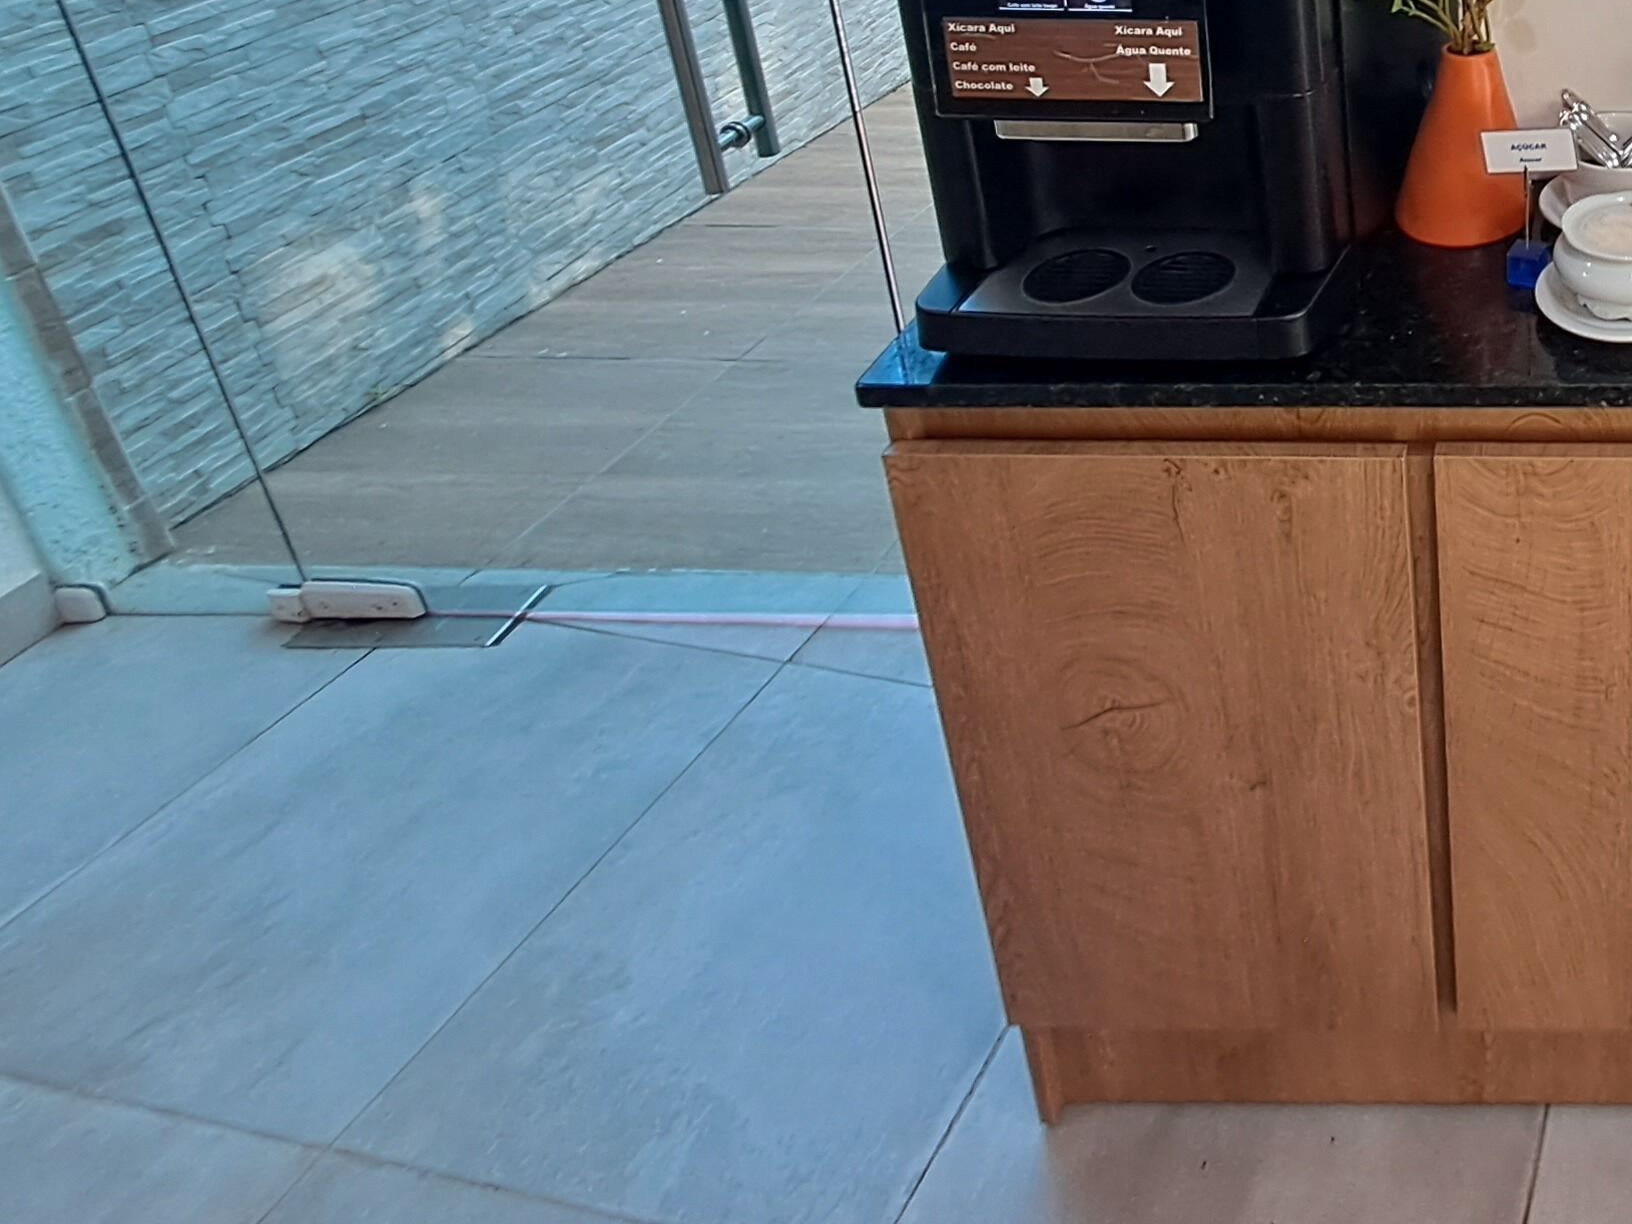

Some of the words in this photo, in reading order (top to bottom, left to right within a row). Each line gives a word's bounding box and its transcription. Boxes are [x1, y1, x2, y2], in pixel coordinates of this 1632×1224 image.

[988, 23, 1016, 35] Aqui
[1155, 26, 1183, 38] Aqui
[950, 41, 977, 52] Café
[1116, 43, 1147, 56] Água
[1149, 45, 1192, 56] Quente
[952, 61, 979, 72] Café
[981, 62, 1007, 72] com
[1008, 62, 1036, 73] leite
[954, 79, 1014, 91] Chocolate
